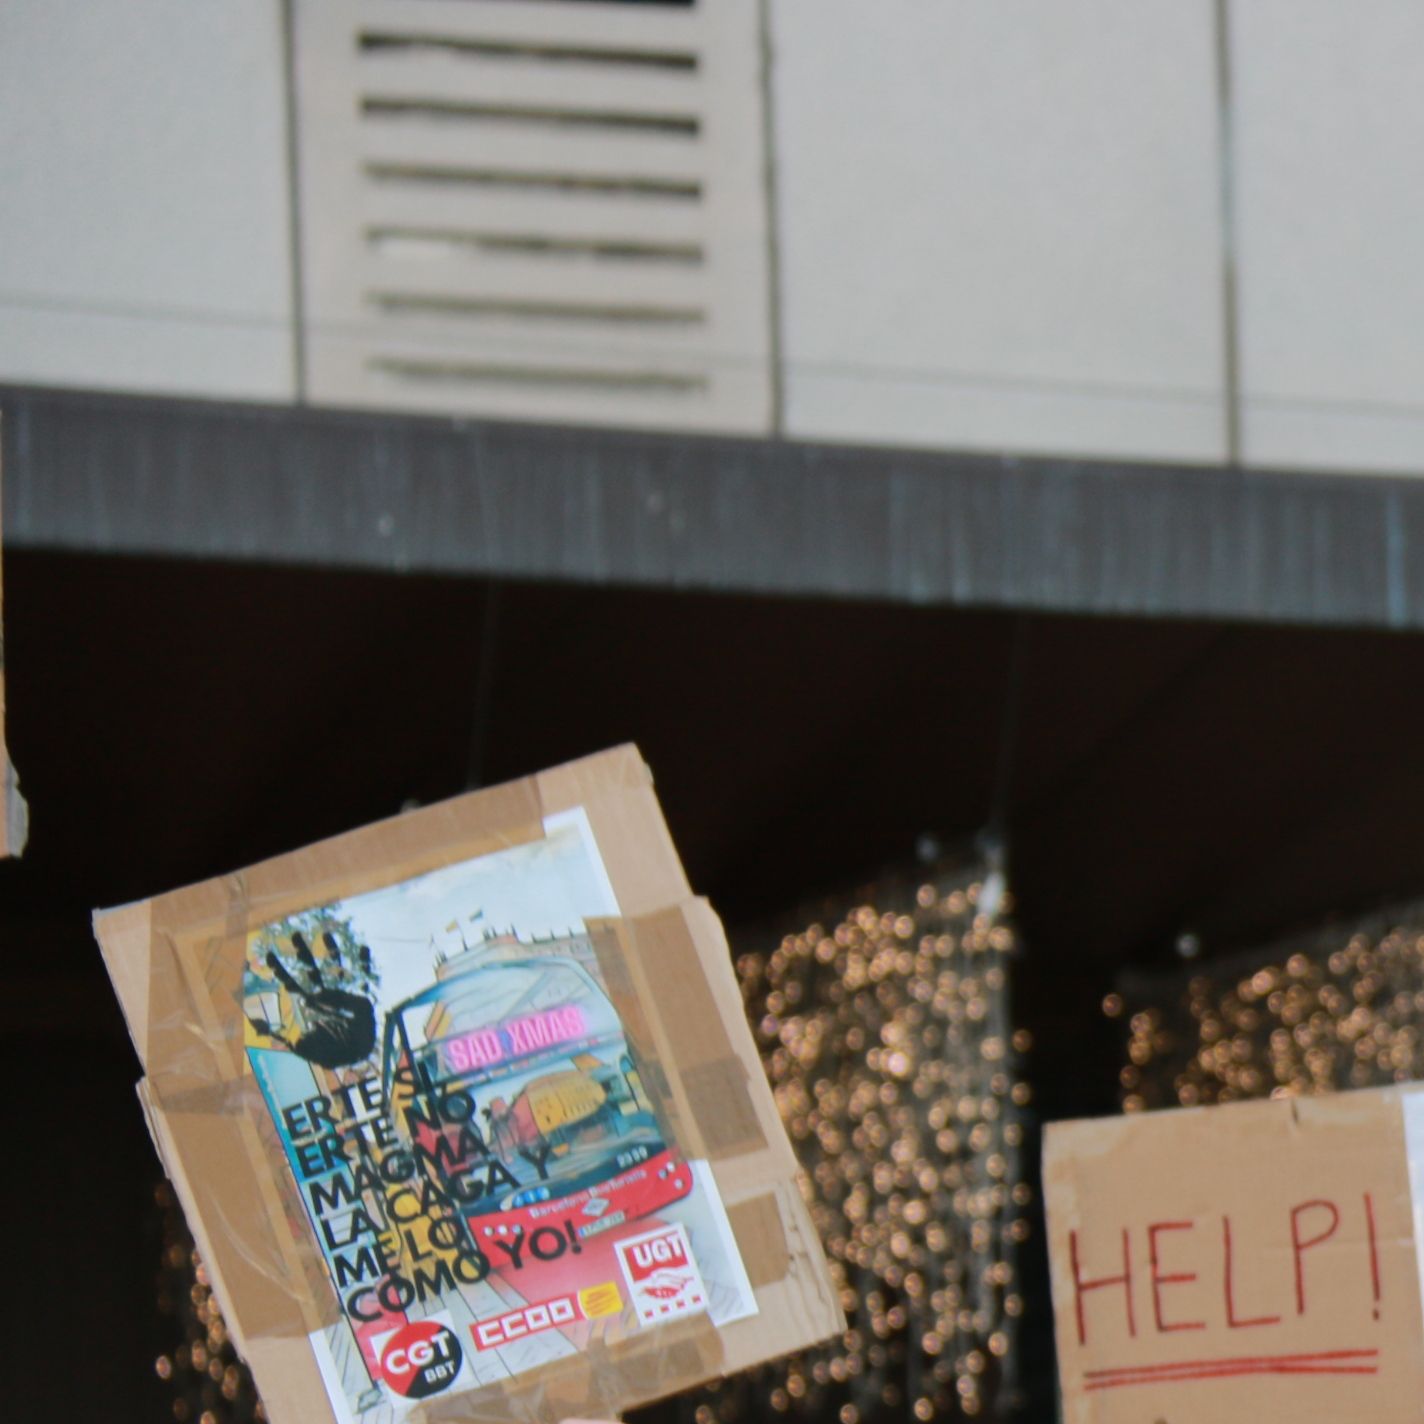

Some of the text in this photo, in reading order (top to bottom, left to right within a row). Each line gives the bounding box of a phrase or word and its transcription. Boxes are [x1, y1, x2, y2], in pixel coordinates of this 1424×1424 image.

[448, 1005, 586, 1073] SAD XMAS
[283, 1076, 383, 1140] ERTE
[294, 1091, 476, 1178] ERTE NO
[308, 1126, 491, 1215] MAGMA
[321, 1144, 549, 1251] LA CAGA Y
[333, 1217, 462, 1287] ME LO
[347, 1251, 490, 1323] COMO
[493, 1220, 582, 1270] YO!
[632, 1234, 684, 1269] UGT
[1069, 1193, 1381, 1347] HELP!
[386, 1331, 451, 1375] CGT
[424, 1362, 456, 1384] BBT
